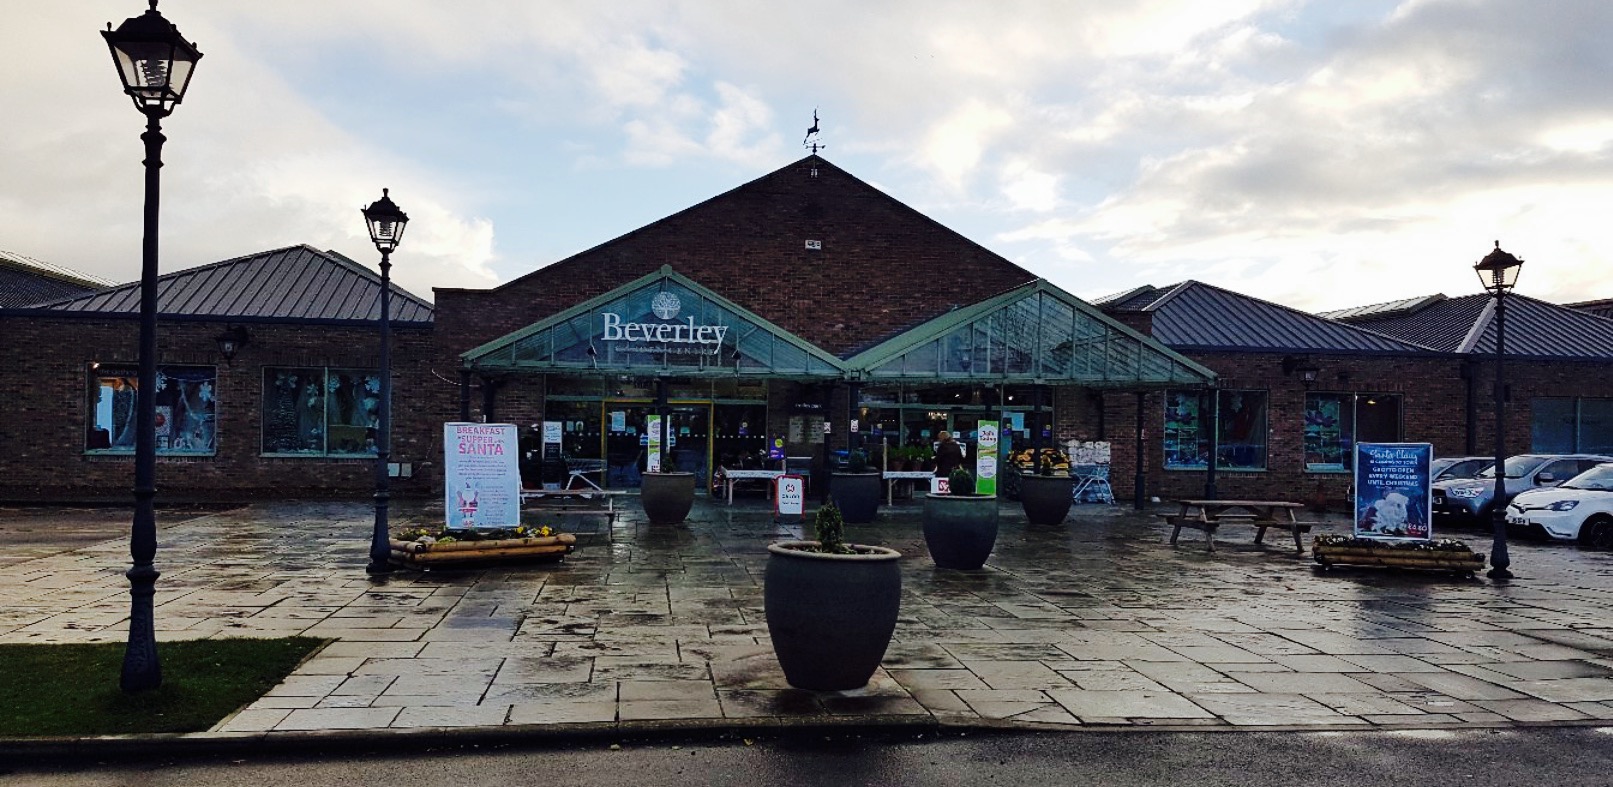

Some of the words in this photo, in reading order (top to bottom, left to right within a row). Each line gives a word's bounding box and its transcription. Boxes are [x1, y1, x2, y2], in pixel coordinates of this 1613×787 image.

[601, 313, 728, 354] Beverley
[456, 426, 505, 435] BREAKFAST
[461, 435, 493, 444] SUPPER
[459, 443, 504, 455] SANTA
